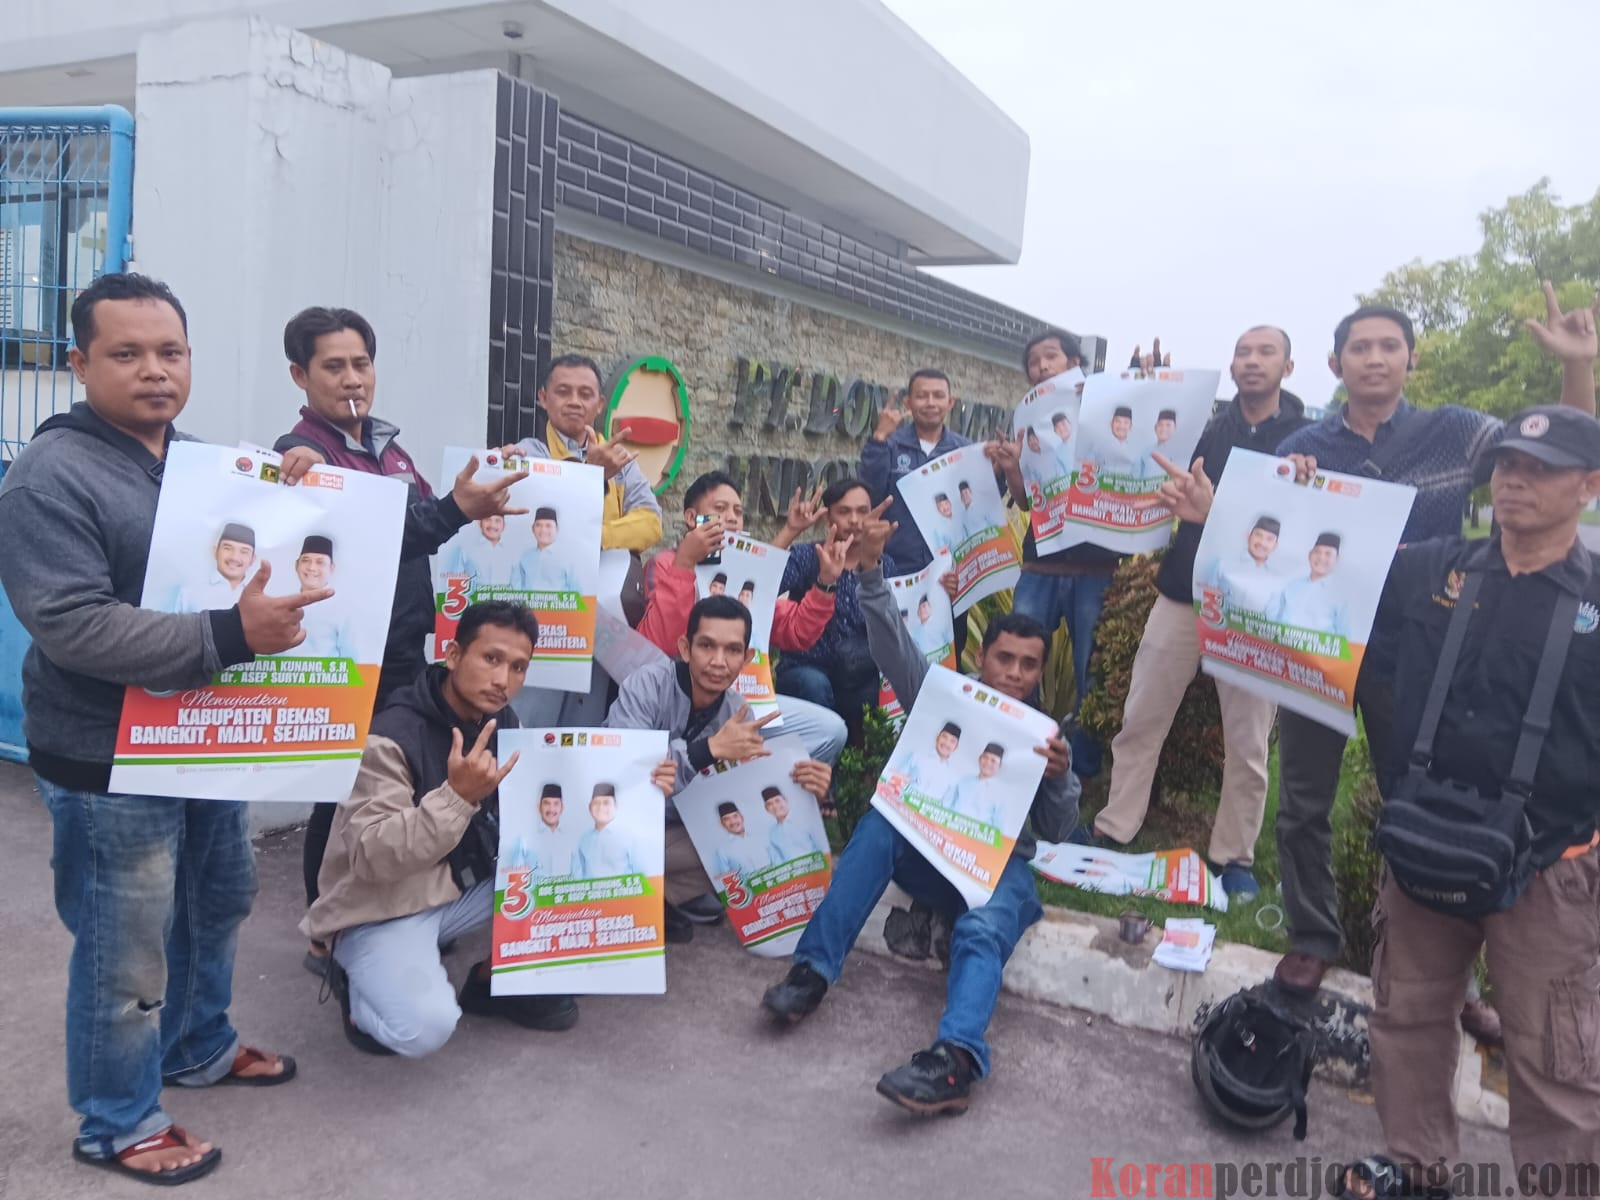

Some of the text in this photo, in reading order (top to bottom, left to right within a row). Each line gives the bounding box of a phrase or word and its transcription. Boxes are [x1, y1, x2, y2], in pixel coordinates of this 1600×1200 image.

[443, 578, 470, 617] 3
[538, 625, 568, 637] EKASI
[240, 672, 267, 684] ASEP
[270, 672, 305, 684] SURYA
[308, 673, 348, 684] ATMAJA
[181, 689, 289, 706] Mewujudkan
[177, 706, 330, 726] KABUPATEN BEKASI
[129, 722, 356, 745] BANGKIT, MAJU, SEJAHTERA
[502, 872, 533, 918] 3
